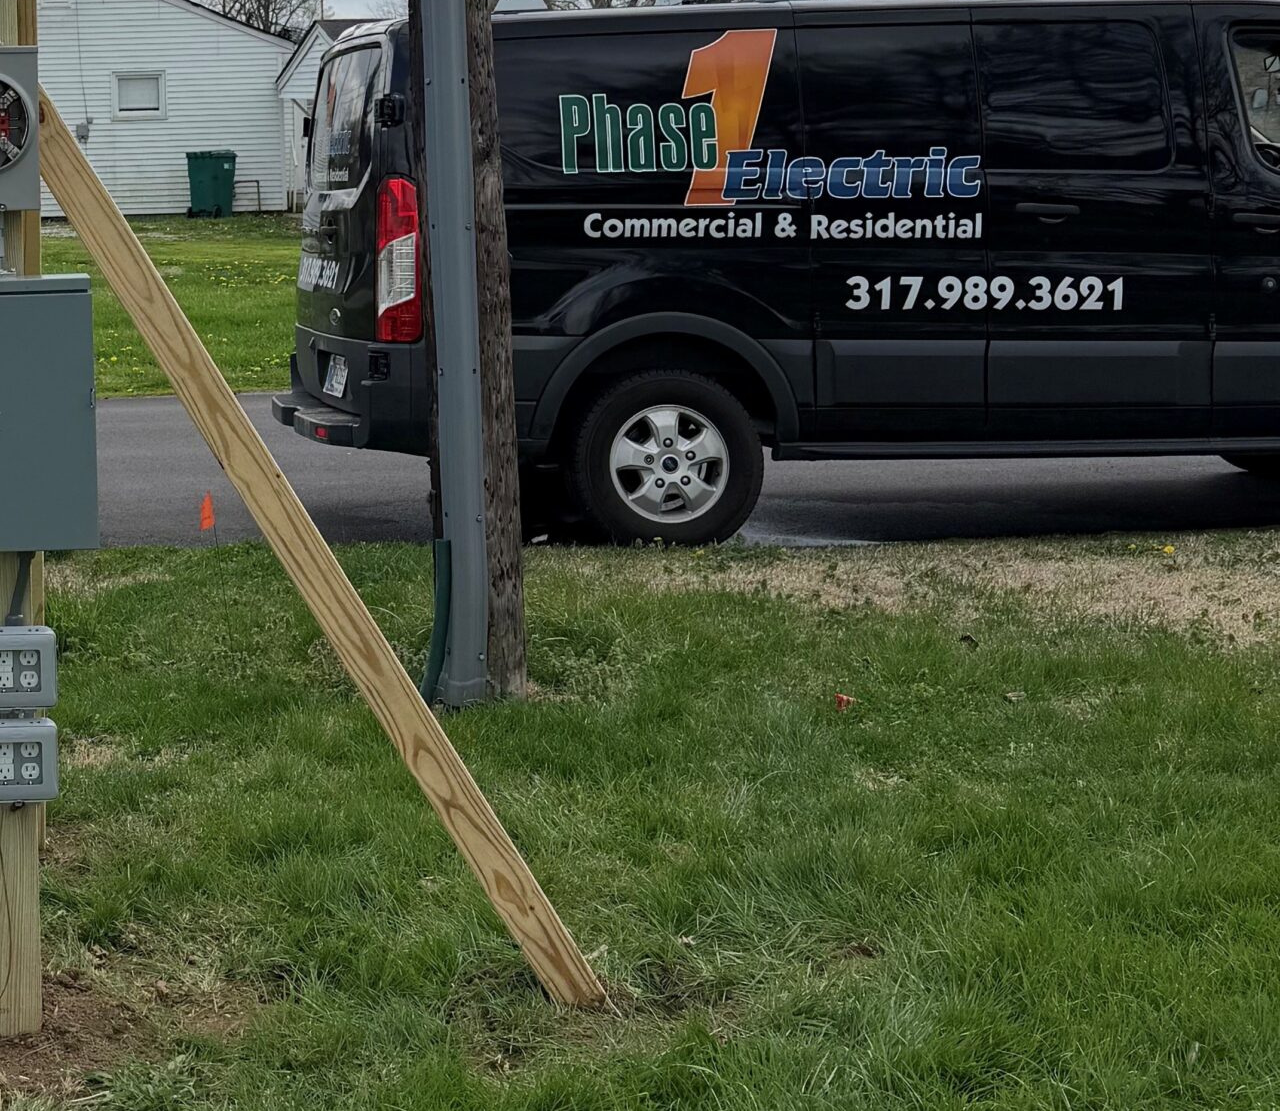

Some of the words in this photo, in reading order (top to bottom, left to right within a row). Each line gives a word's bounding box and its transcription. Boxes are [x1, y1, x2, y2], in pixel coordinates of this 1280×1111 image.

[559, 94, 718, 174] Phase
[682, 28, 777, 206] 1
[720, 147, 981, 200] Electric
[583, 212, 762, 238] Commercial
[773, 213, 797, 239] &
[810, 212, 983, 240] Residential
[845, 275, 1123, 310] 317.989.3621
